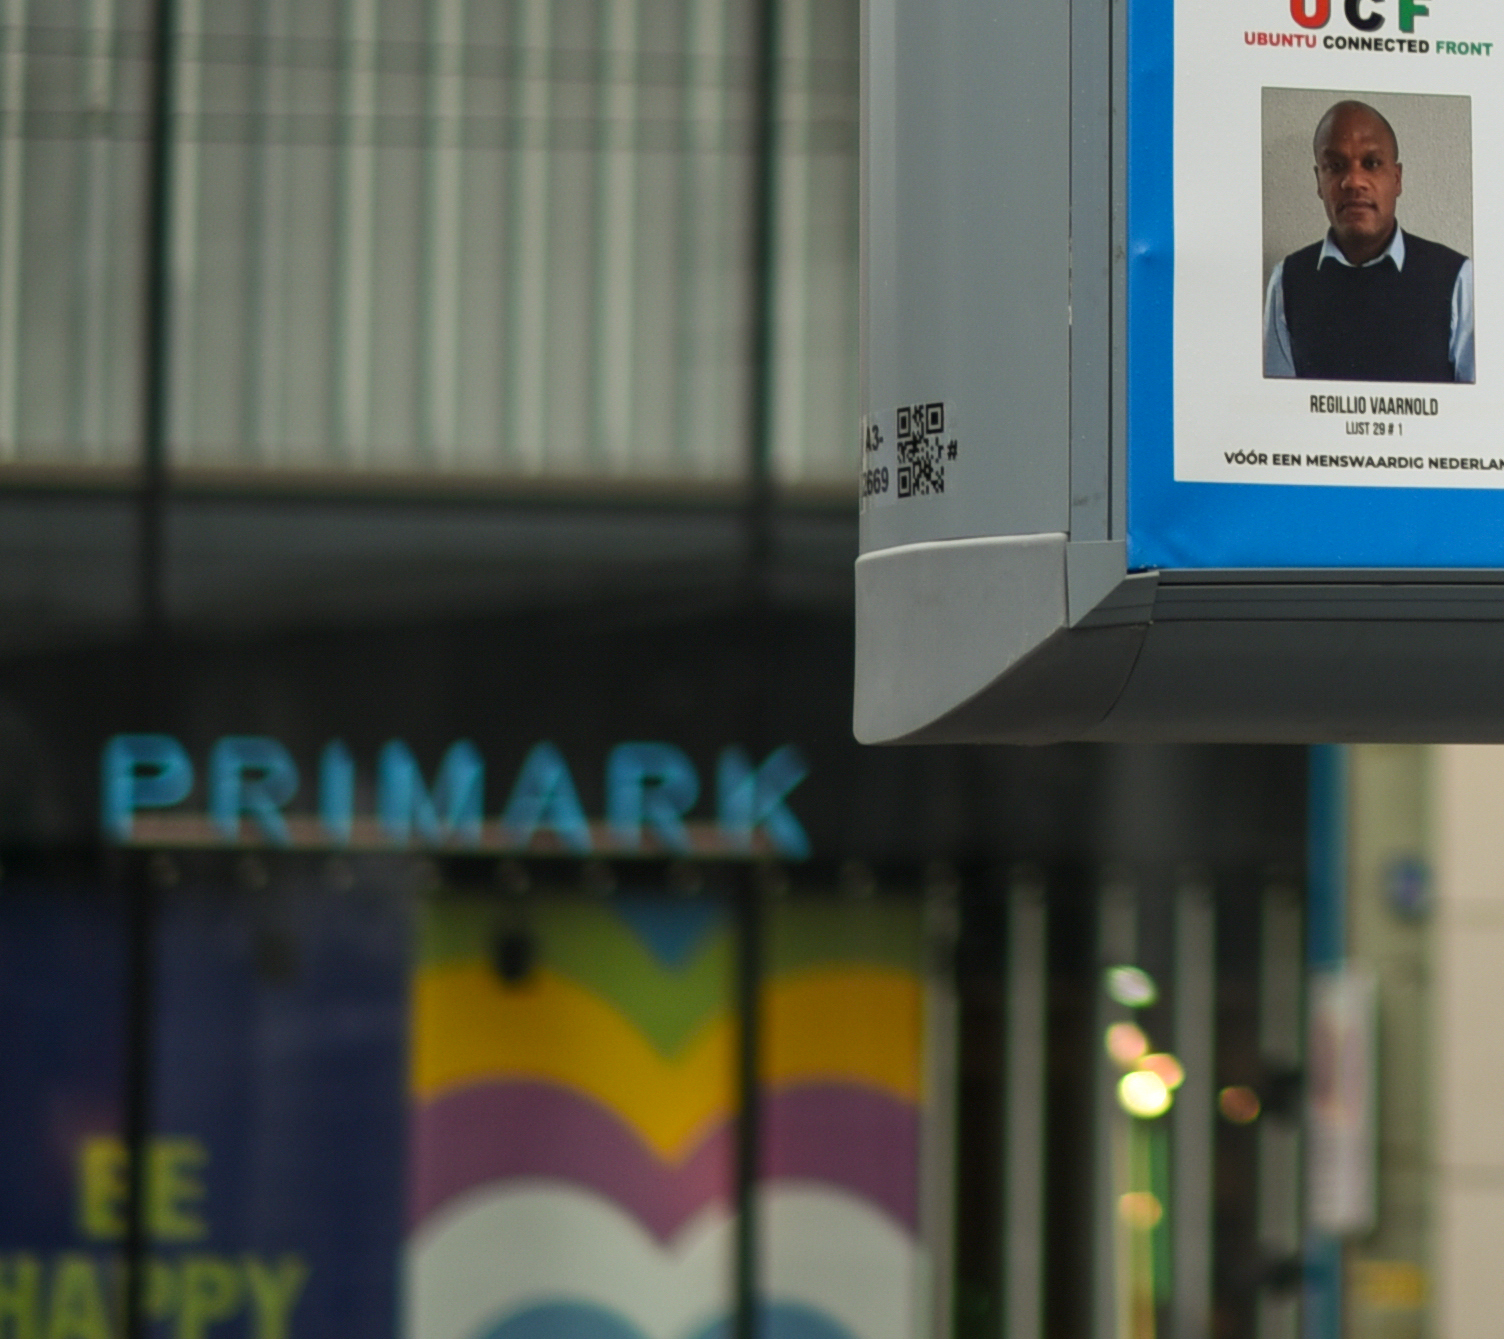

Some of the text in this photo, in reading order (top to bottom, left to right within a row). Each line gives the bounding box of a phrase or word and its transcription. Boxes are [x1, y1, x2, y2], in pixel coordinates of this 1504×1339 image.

[1243, 31, 1493, 57] UBUNTU CONNECTED FRONT
[1310, 394, 1438, 416] REGILLIO VAARNOLD
[1224, 449, 1268, 466] VÓÓR
[1272, 454, 1301, 466] EEN
[1306, 455, 1424, 470] MENSWAARDIG
[100, 734, 810, 859] PRIMARK
